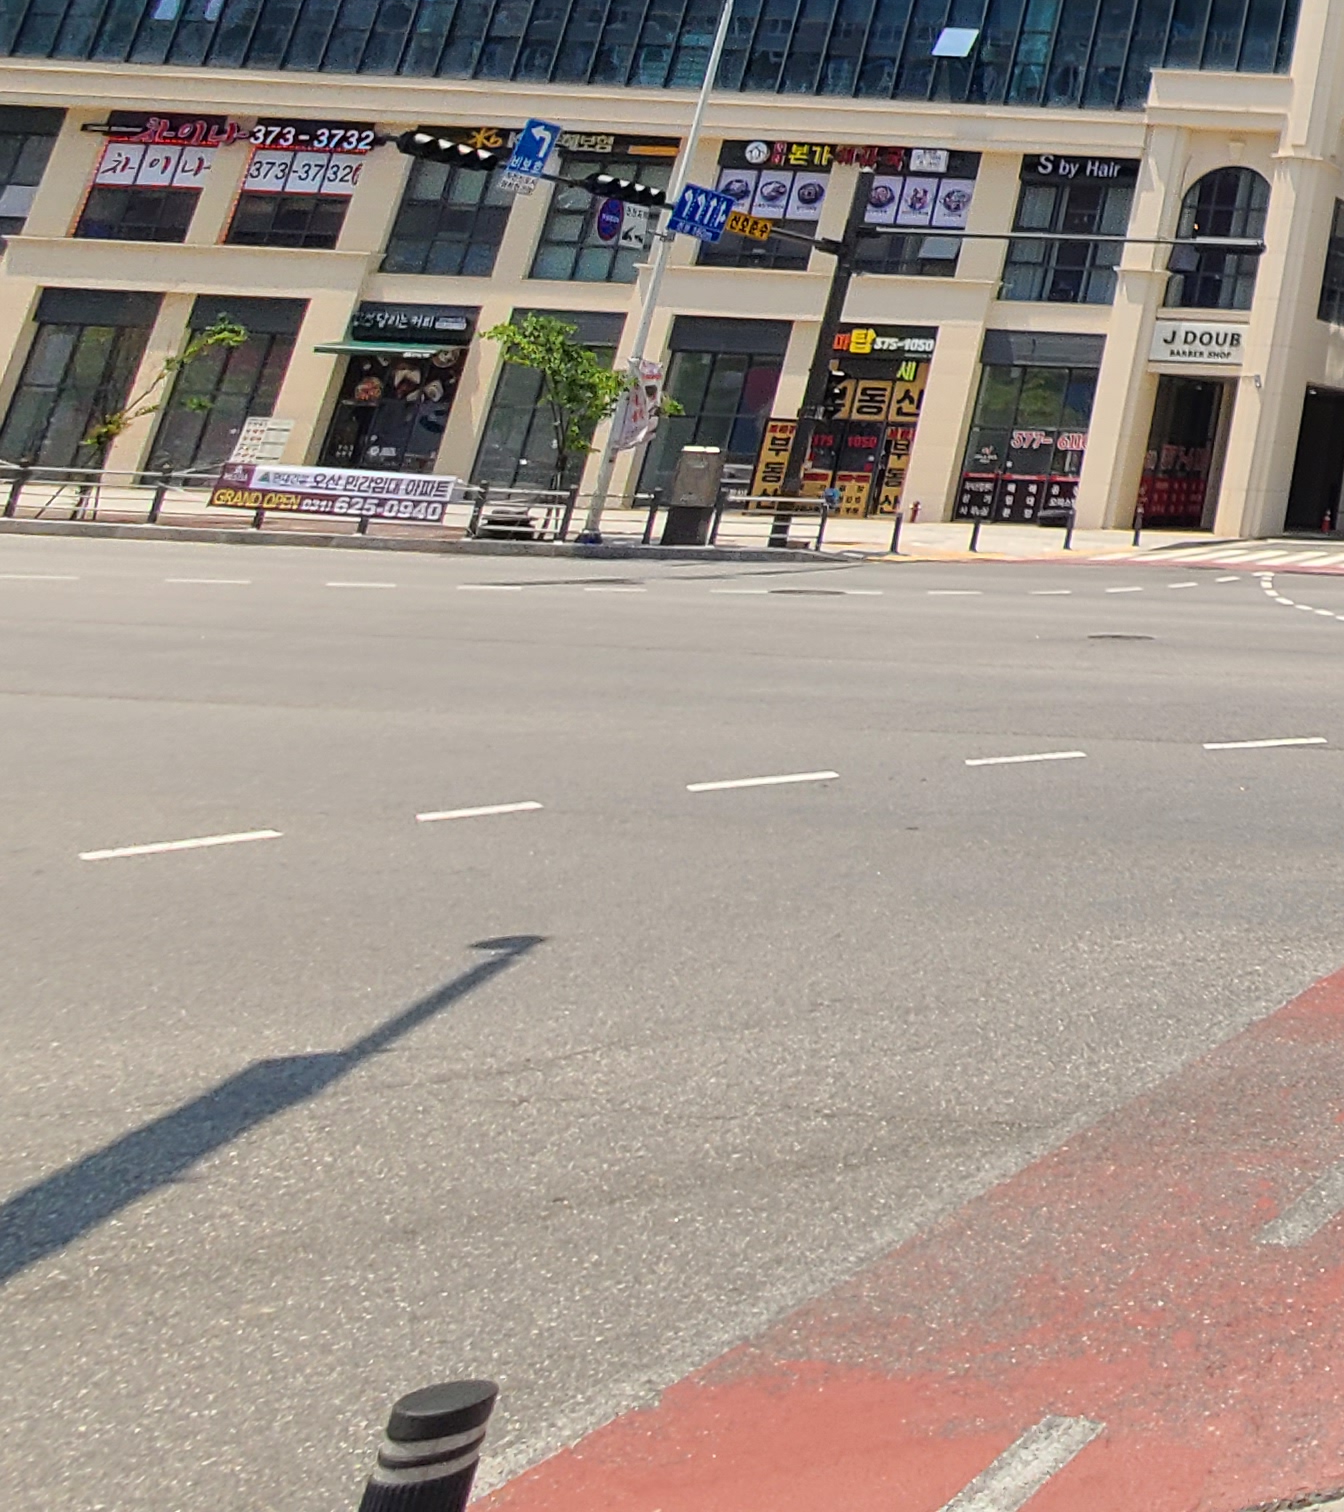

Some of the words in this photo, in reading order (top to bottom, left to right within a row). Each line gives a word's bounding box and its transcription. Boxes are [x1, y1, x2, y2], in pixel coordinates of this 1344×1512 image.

[511, 155, 544, 174] 비보호
[1037, 154, 1054, 176] S
[1058, 160, 1079, 179] by
[1086, 160, 1121, 178] Hair
[1163, 329, 1177, 345] J
[1183, 329, 1243, 348] DOUB
[406, 478, 452, 499] 아파트
[334, 496, 442, 521] 625-0940
